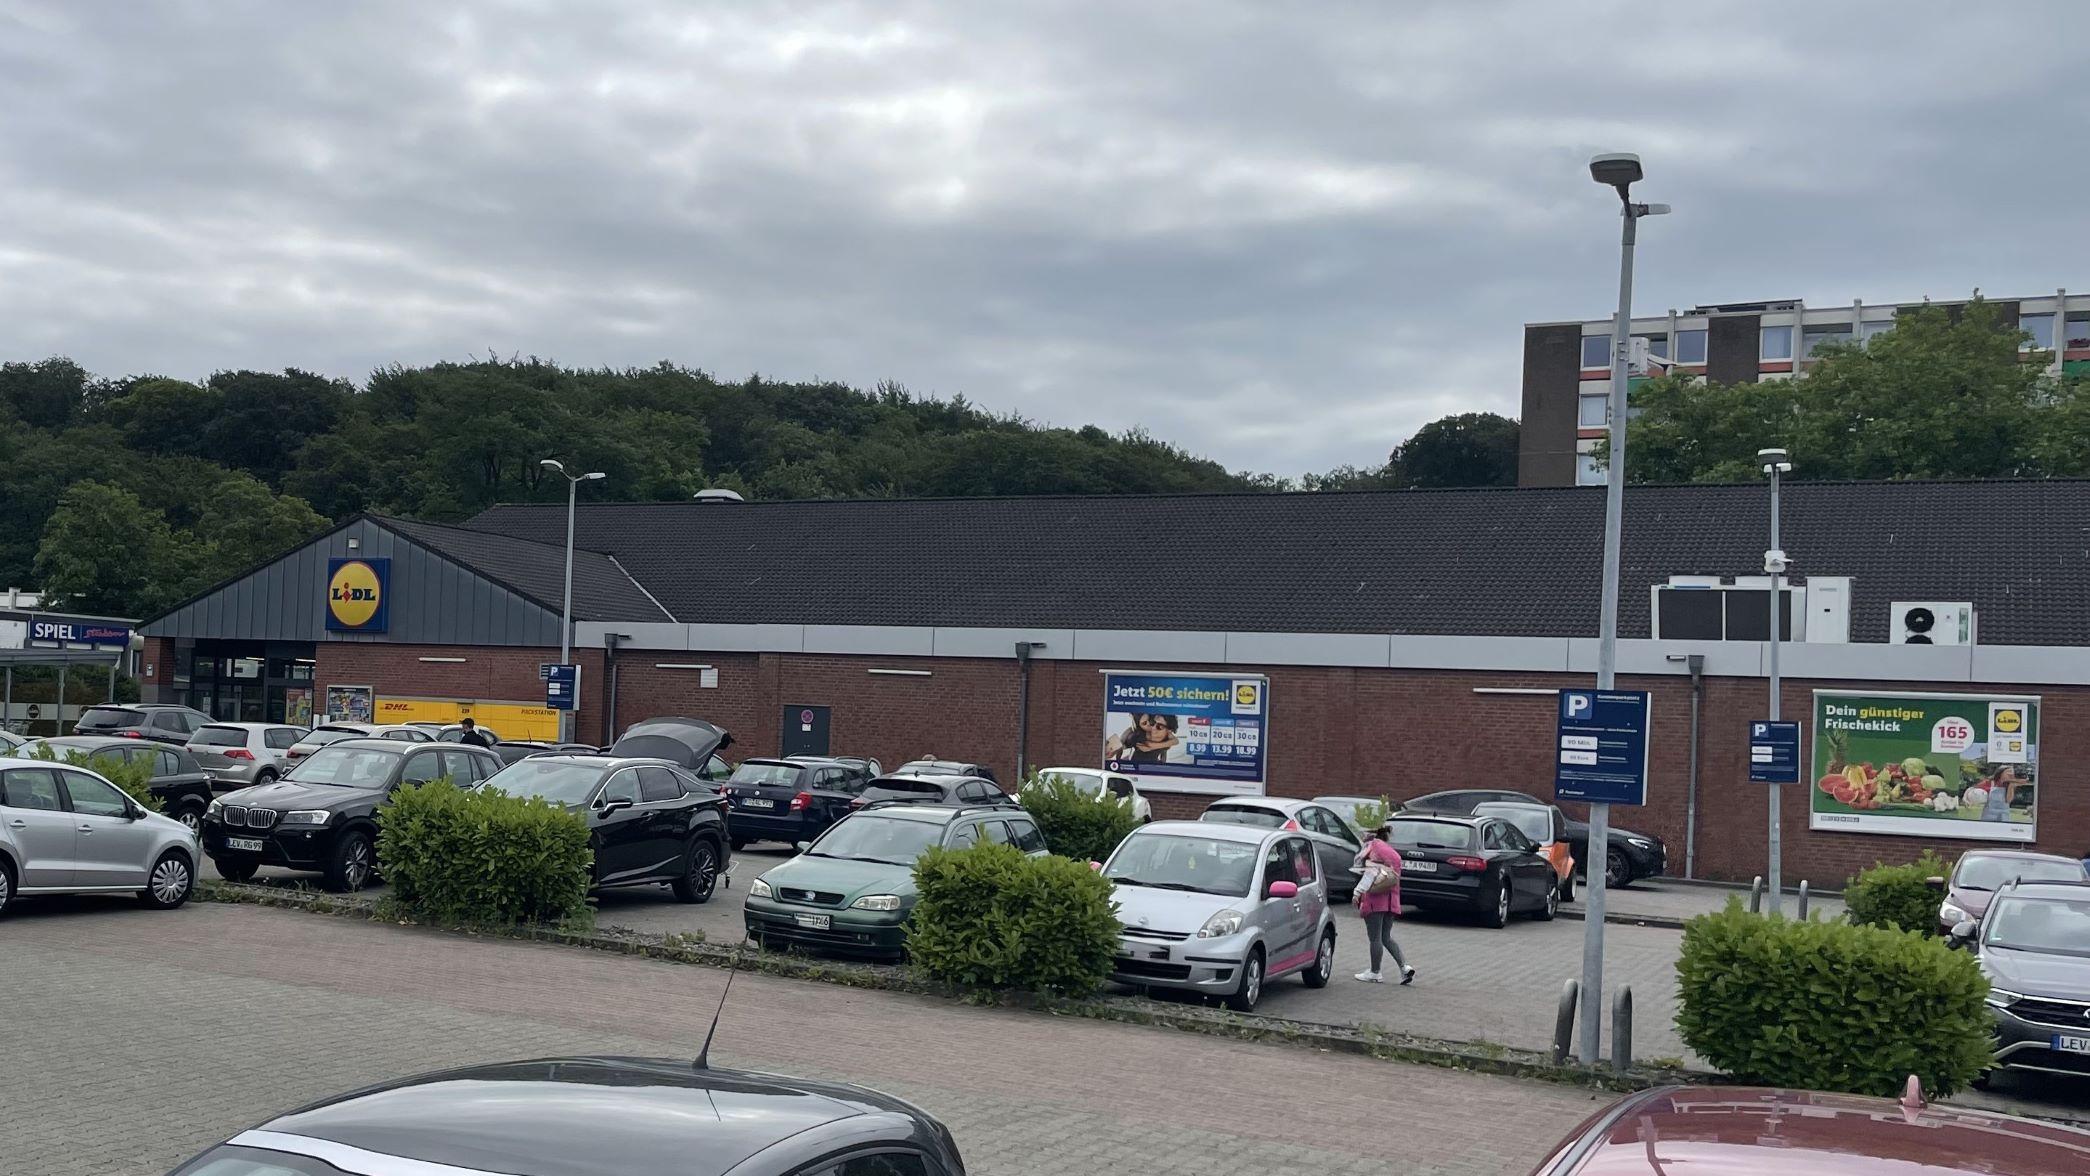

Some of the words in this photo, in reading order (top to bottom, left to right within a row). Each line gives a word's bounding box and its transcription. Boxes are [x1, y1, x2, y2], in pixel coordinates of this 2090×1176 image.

[332, 582, 376, 604] LIDL
[35, 622, 76, 640] SPIEL
[550, 667, 558, 676] P
[1113, 685, 1145, 698] Jetzt
[1147, 686, 1173, 698] 50€
[1176, 688, 1230, 701] sichern!
[384, 703, 409, 711] DHL
[1568, 694, 1588, 717] P
[1825, 704, 1857, 716] Dein
[1859, 706, 1925, 720] günstiger
[1754, 723, 1767, 737] P
[1825, 718, 1901, 732] Frischekick
[1212, 731, 1223, 739] 20
[1938, 726, 1968, 739] 165
[1189, 743, 1207, 753] 8.99
[1212, 745, 1232, 754] 13.99
[1236, 746, 1257, 755] 18.99
[2061, 1037, 2088, 1051] LEV
